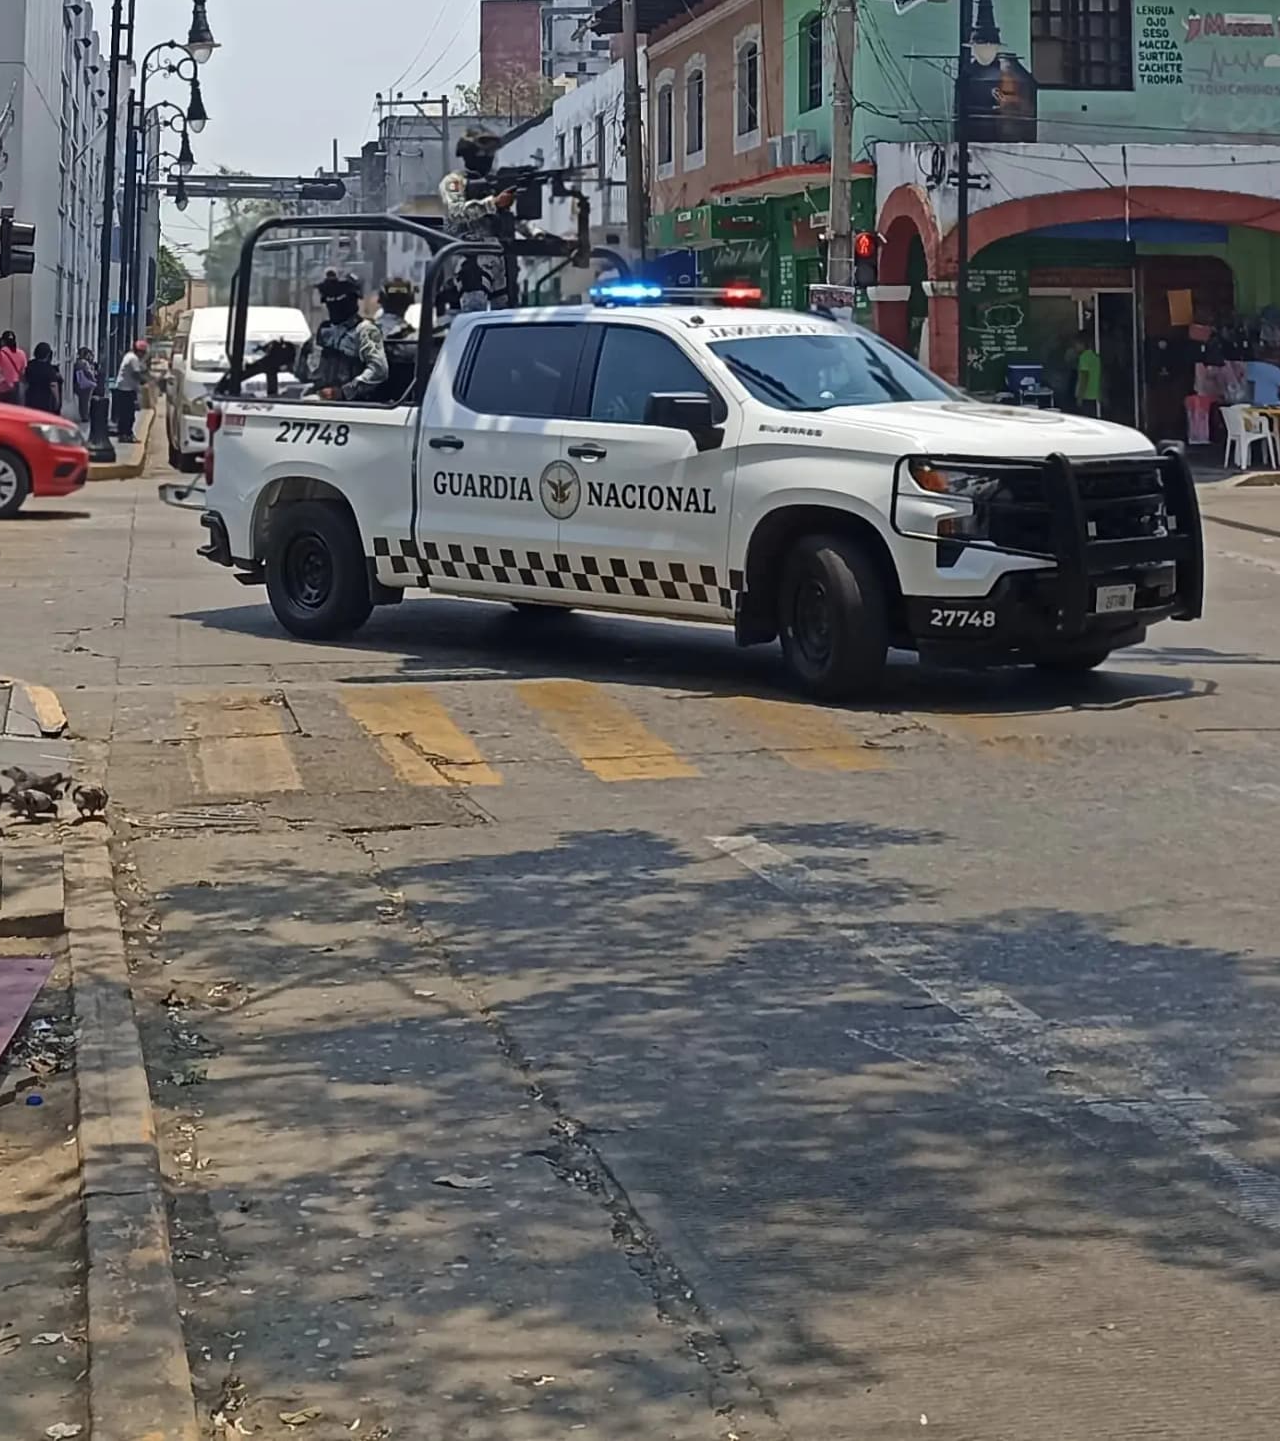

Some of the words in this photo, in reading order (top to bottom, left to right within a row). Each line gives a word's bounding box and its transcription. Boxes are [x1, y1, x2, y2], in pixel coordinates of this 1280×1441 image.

[1136, 6, 1175, 18] LENGUA
[1146, 17, 1167, 27] OJO
[1143, 29, 1169, 38] SESO
[1139, 40, 1178, 50] MACIZA
[1139, 51, 1183, 62] SURTIDA
[1138, 63, 1183, 73] CACHETE
[1139, 75, 1183, 85] TROMPA
[275, 421, 350, 447] 27748
[433, 471, 534, 502] GUARDIA
[587, 481, 717, 514] NACIONAL
[930, 609, 996, 628] 27748
